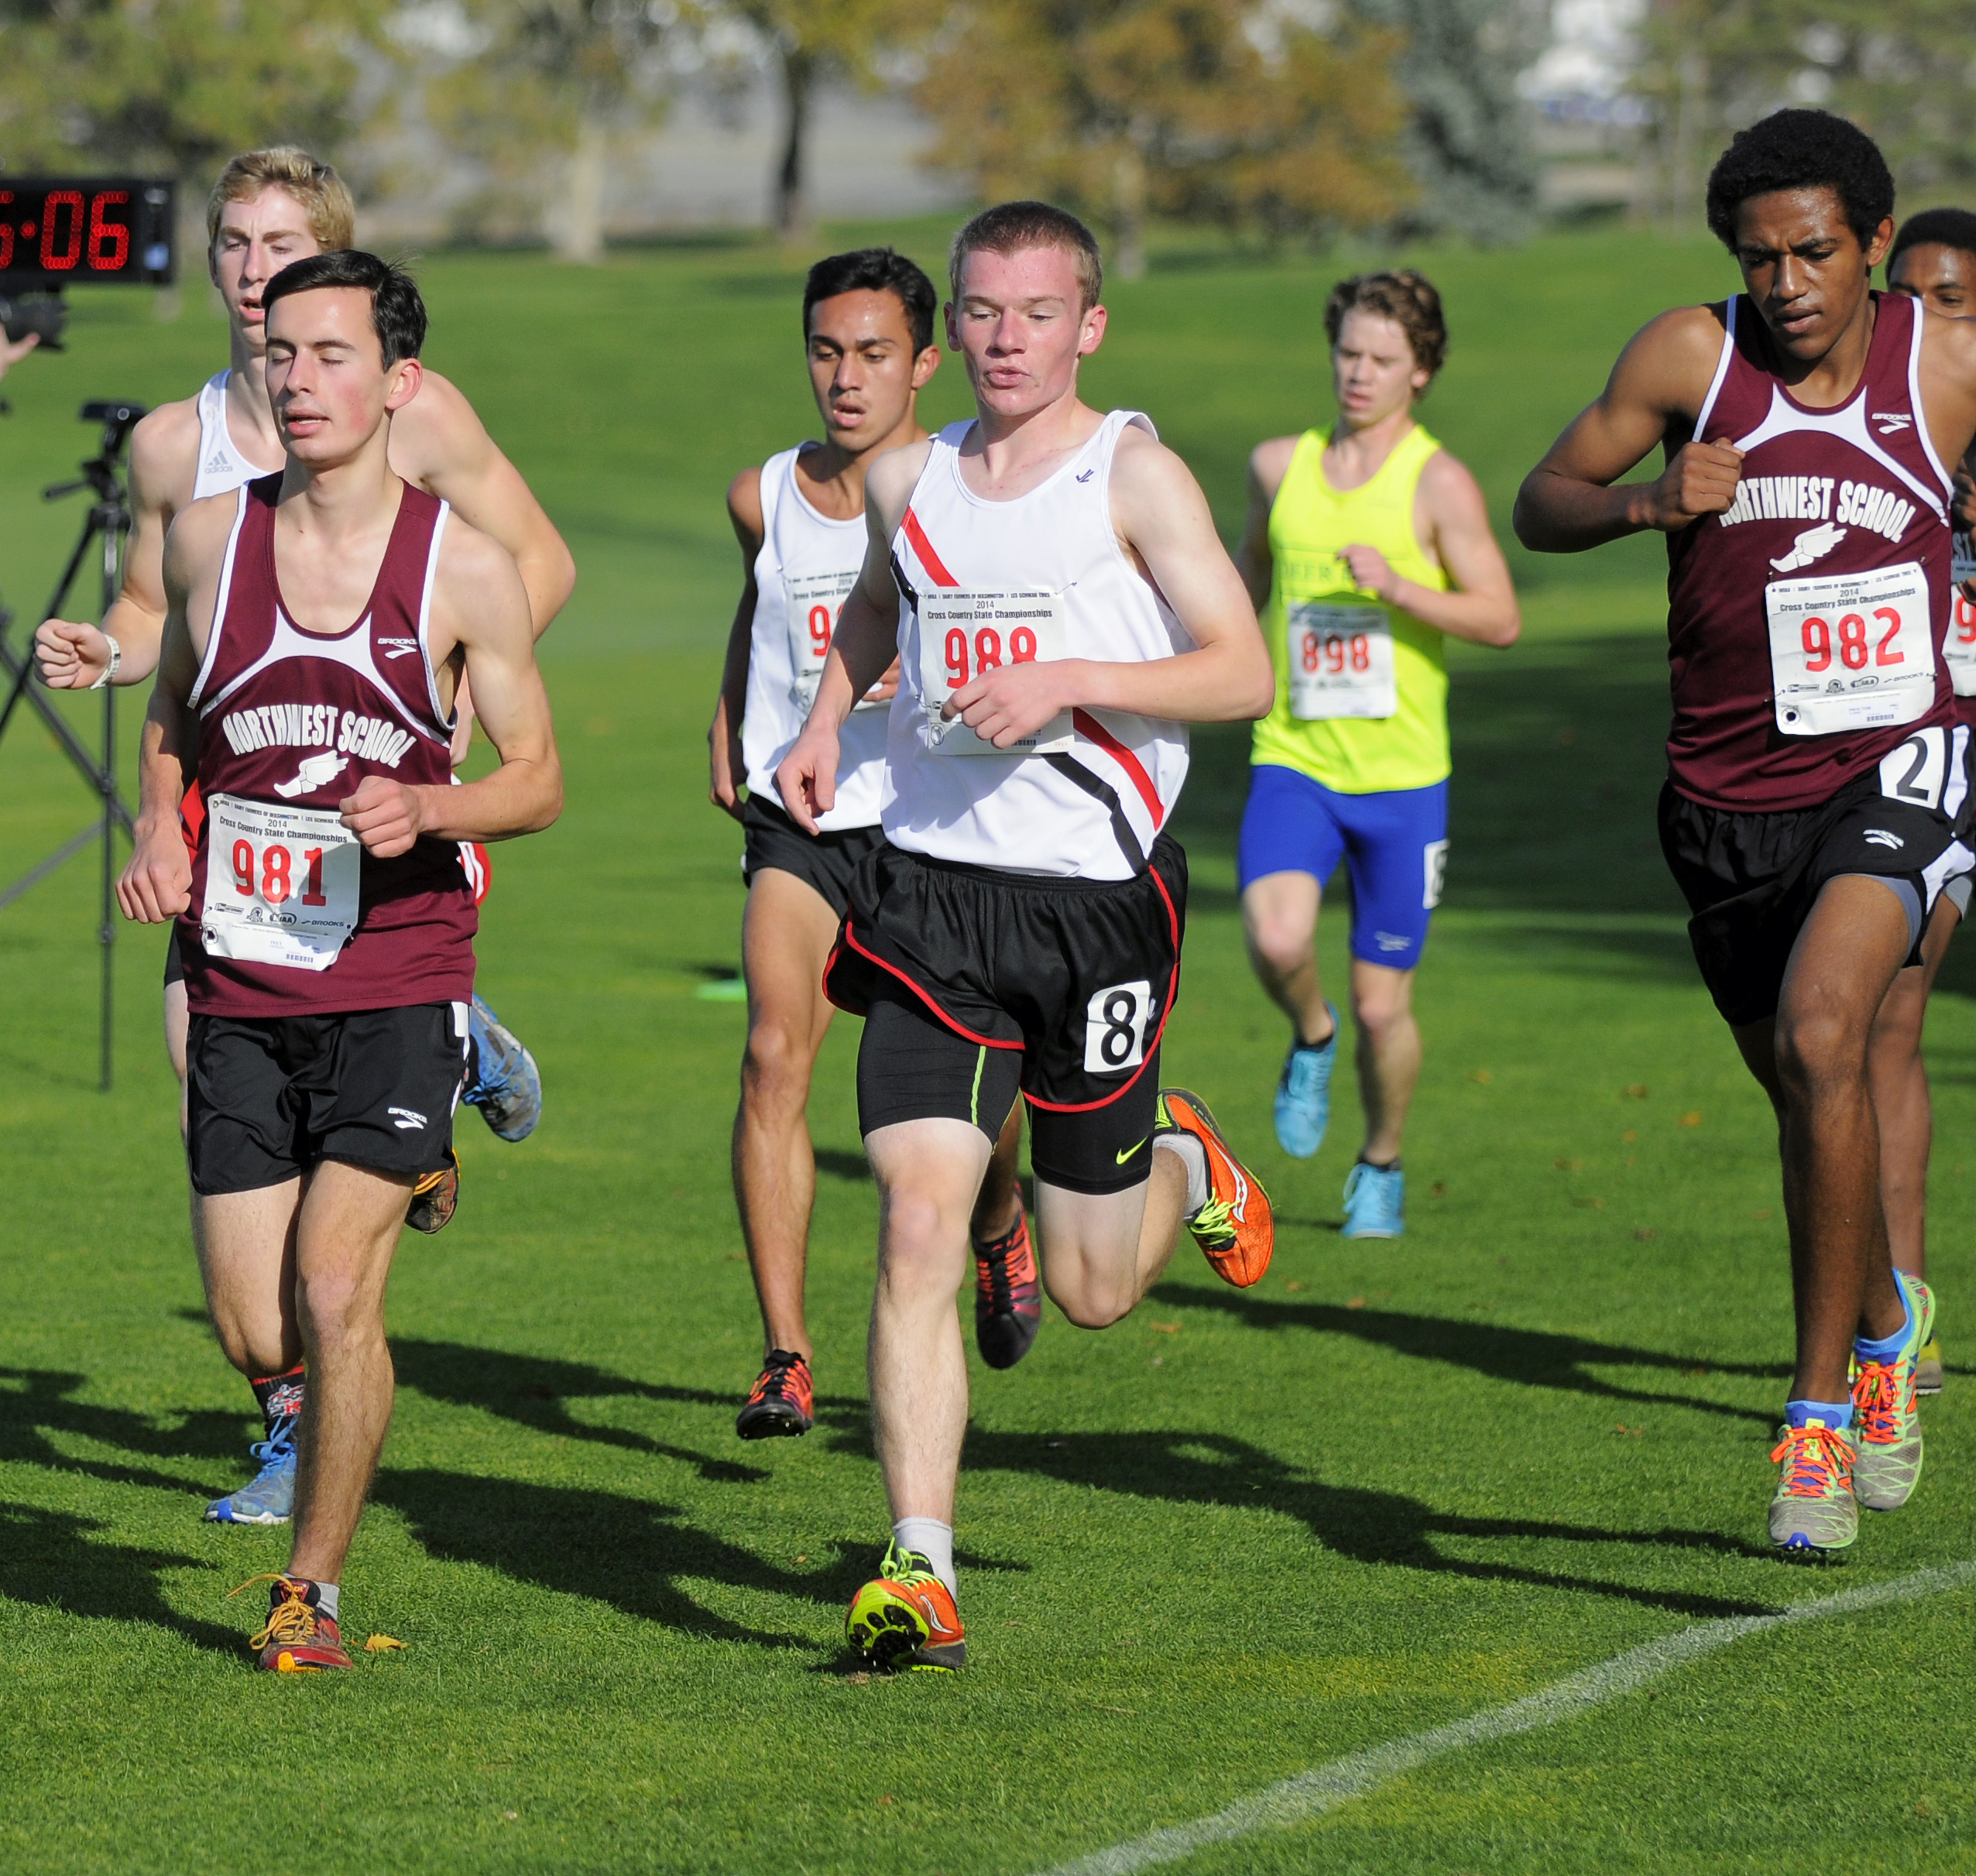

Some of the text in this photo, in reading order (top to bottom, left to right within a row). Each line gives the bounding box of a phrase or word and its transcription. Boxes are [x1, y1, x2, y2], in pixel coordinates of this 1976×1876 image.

[1837, 480, 1916, 543] SCHOOL
[928, 609, 1052, 620] Cross Country State Championships
[1805, 602, 1835, 610] Country
[1840, 588, 1859, 597] 2014
[945, 626, 1038, 688] 988
[1302, 633, 1369, 672] 898
[1801, 607, 1905, 672] 982
[222, 704, 417, 768] NORTHWEST SCHOOL
[1896, 736, 1930, 801] 2
[220, 815, 348, 843] Cross Country State Championships
[268, 818, 287, 828] 2014
[233, 839, 326, 906] 981
[1101, 989, 1137, 1065] 8
